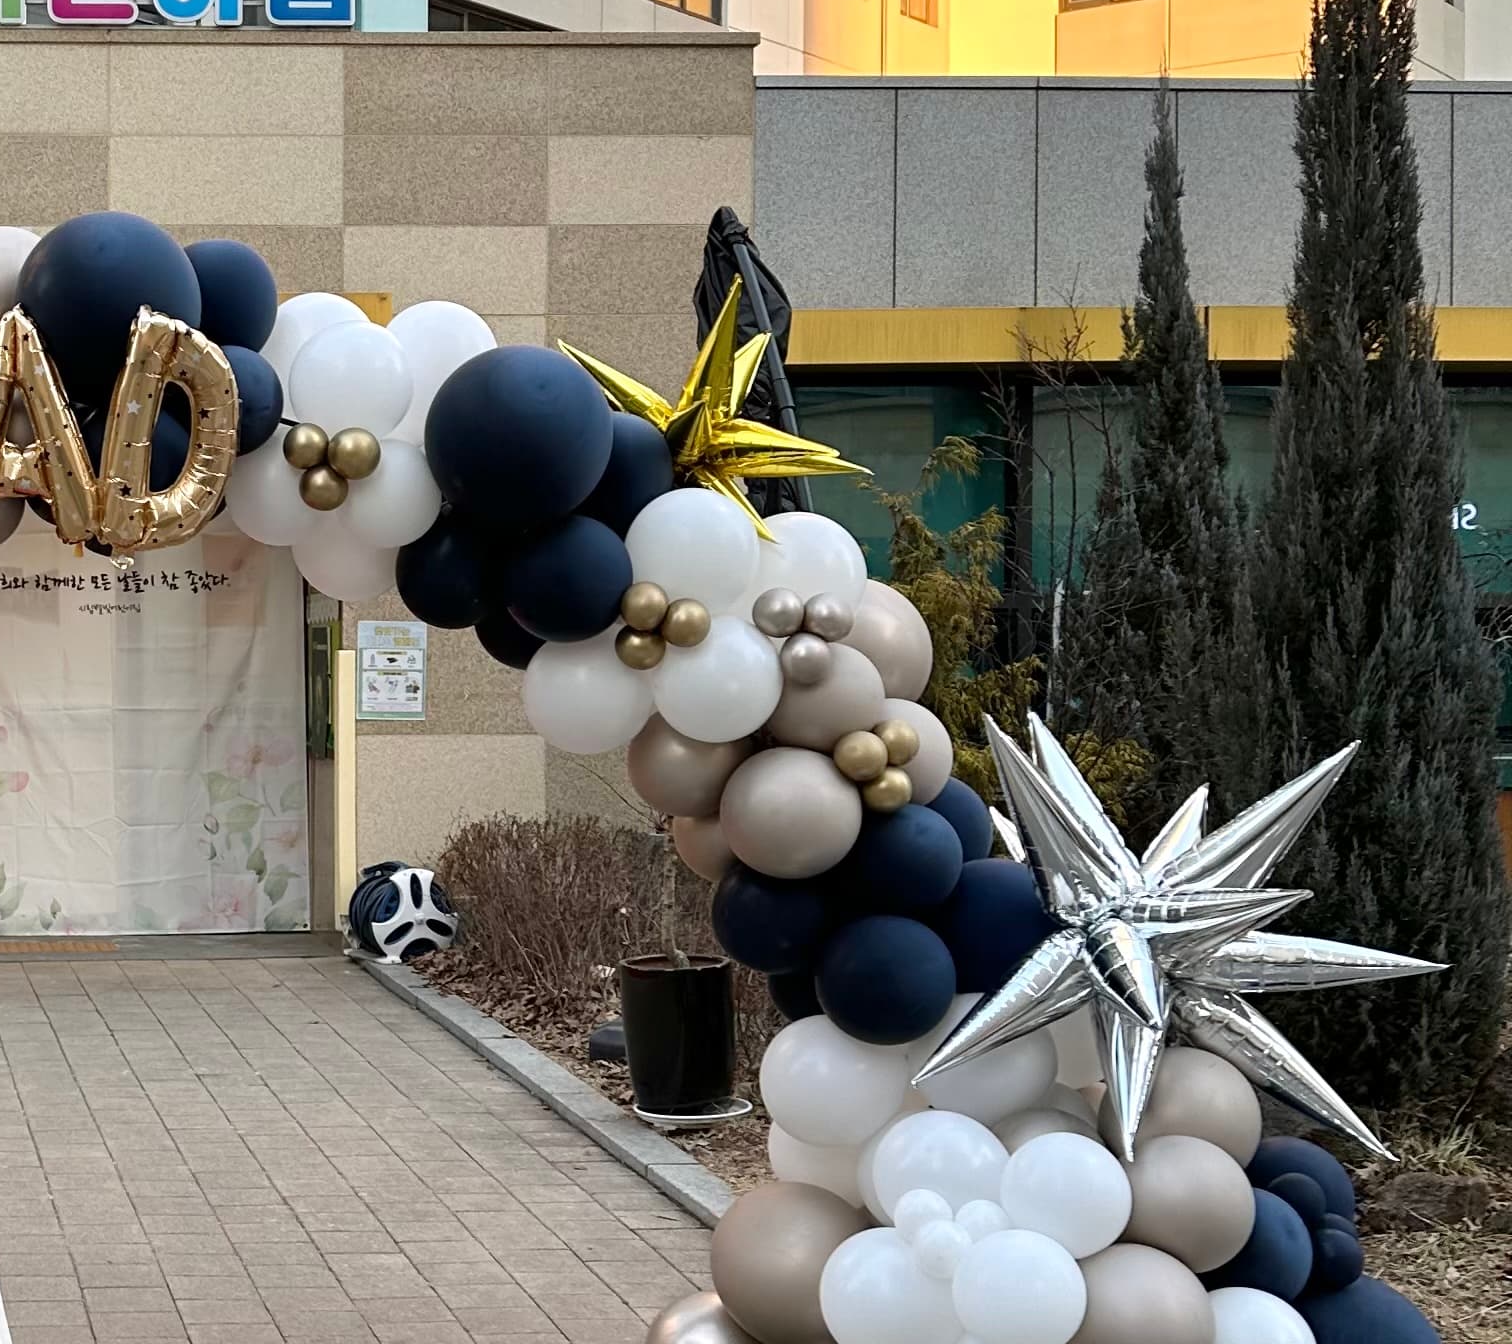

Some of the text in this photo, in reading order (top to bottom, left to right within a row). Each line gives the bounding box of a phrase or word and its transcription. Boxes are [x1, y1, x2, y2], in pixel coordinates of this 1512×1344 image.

[34, 574, 85, 592] 함께한
[90, 573, 112, 591] 모든
[117, 570, 155, 594] 날들이
[160, 570, 180, 591] 참
